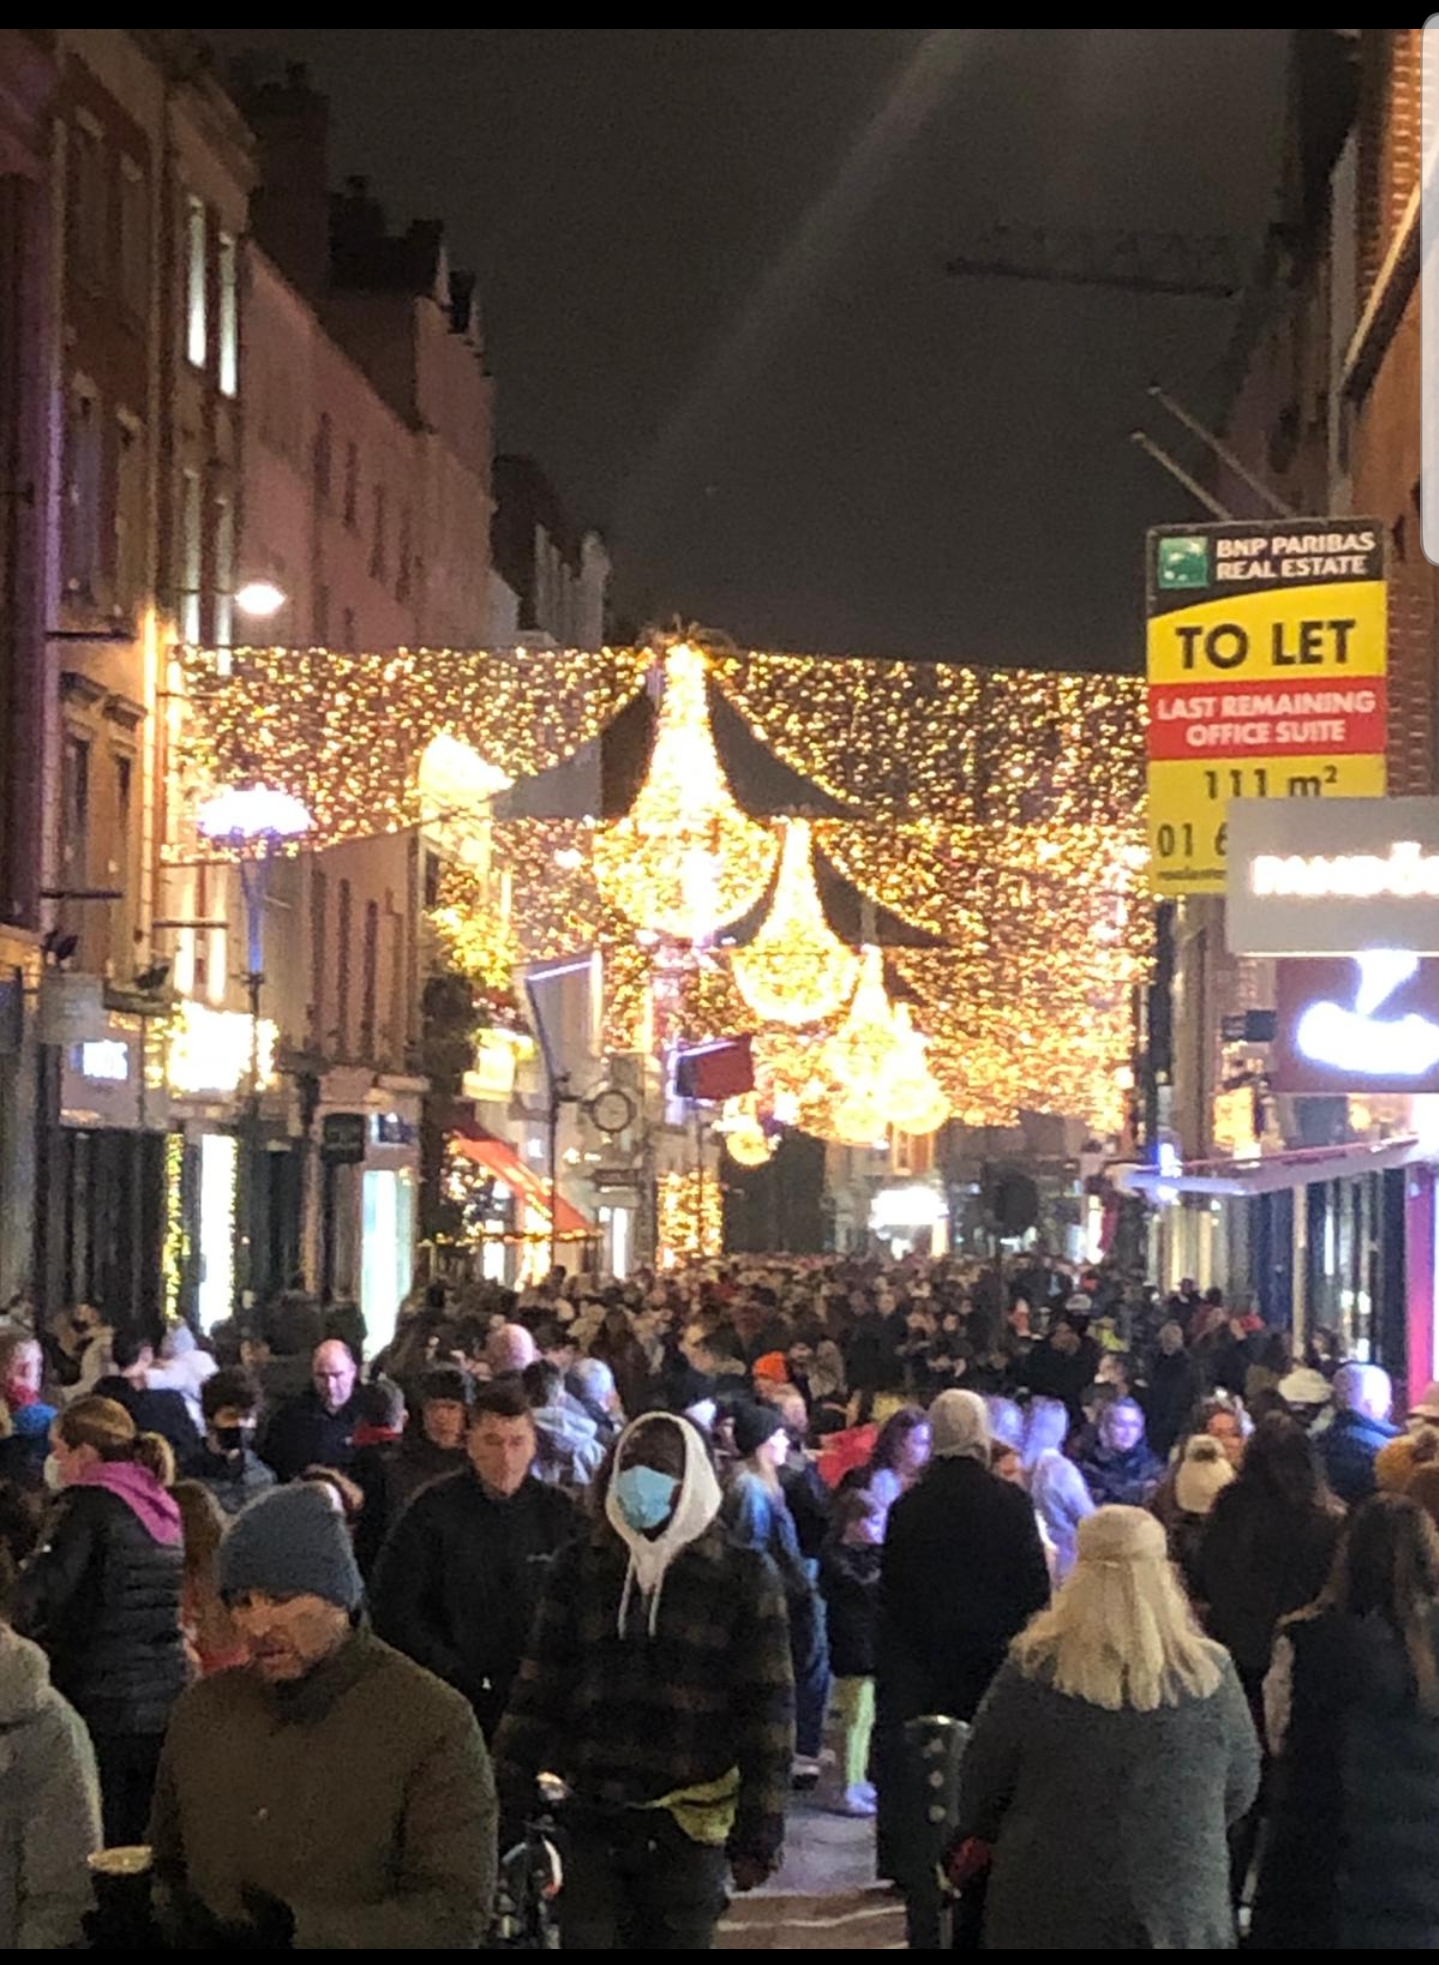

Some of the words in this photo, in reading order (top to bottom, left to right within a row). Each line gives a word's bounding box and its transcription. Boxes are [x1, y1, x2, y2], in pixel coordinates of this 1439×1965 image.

[1216, 538, 1268, 558] BNP
[1271, 531, 1377, 555] PARIBAS
[1216, 560, 1277, 580] REAL
[1281, 554, 1369, 577] ESTATE
[1175, 623, 1249, 669] TO
[1272, 619, 1356, 666] LET
[1157, 697, 1218, 720] LAST
[1220, 690, 1376, 718] REMAINING
[1186, 722, 1271, 747] OFFICE
[1275, 719, 1347, 742] SUITE
[1204, 768, 1267, 799] 111
[1157, 823, 1193, 857] 01
